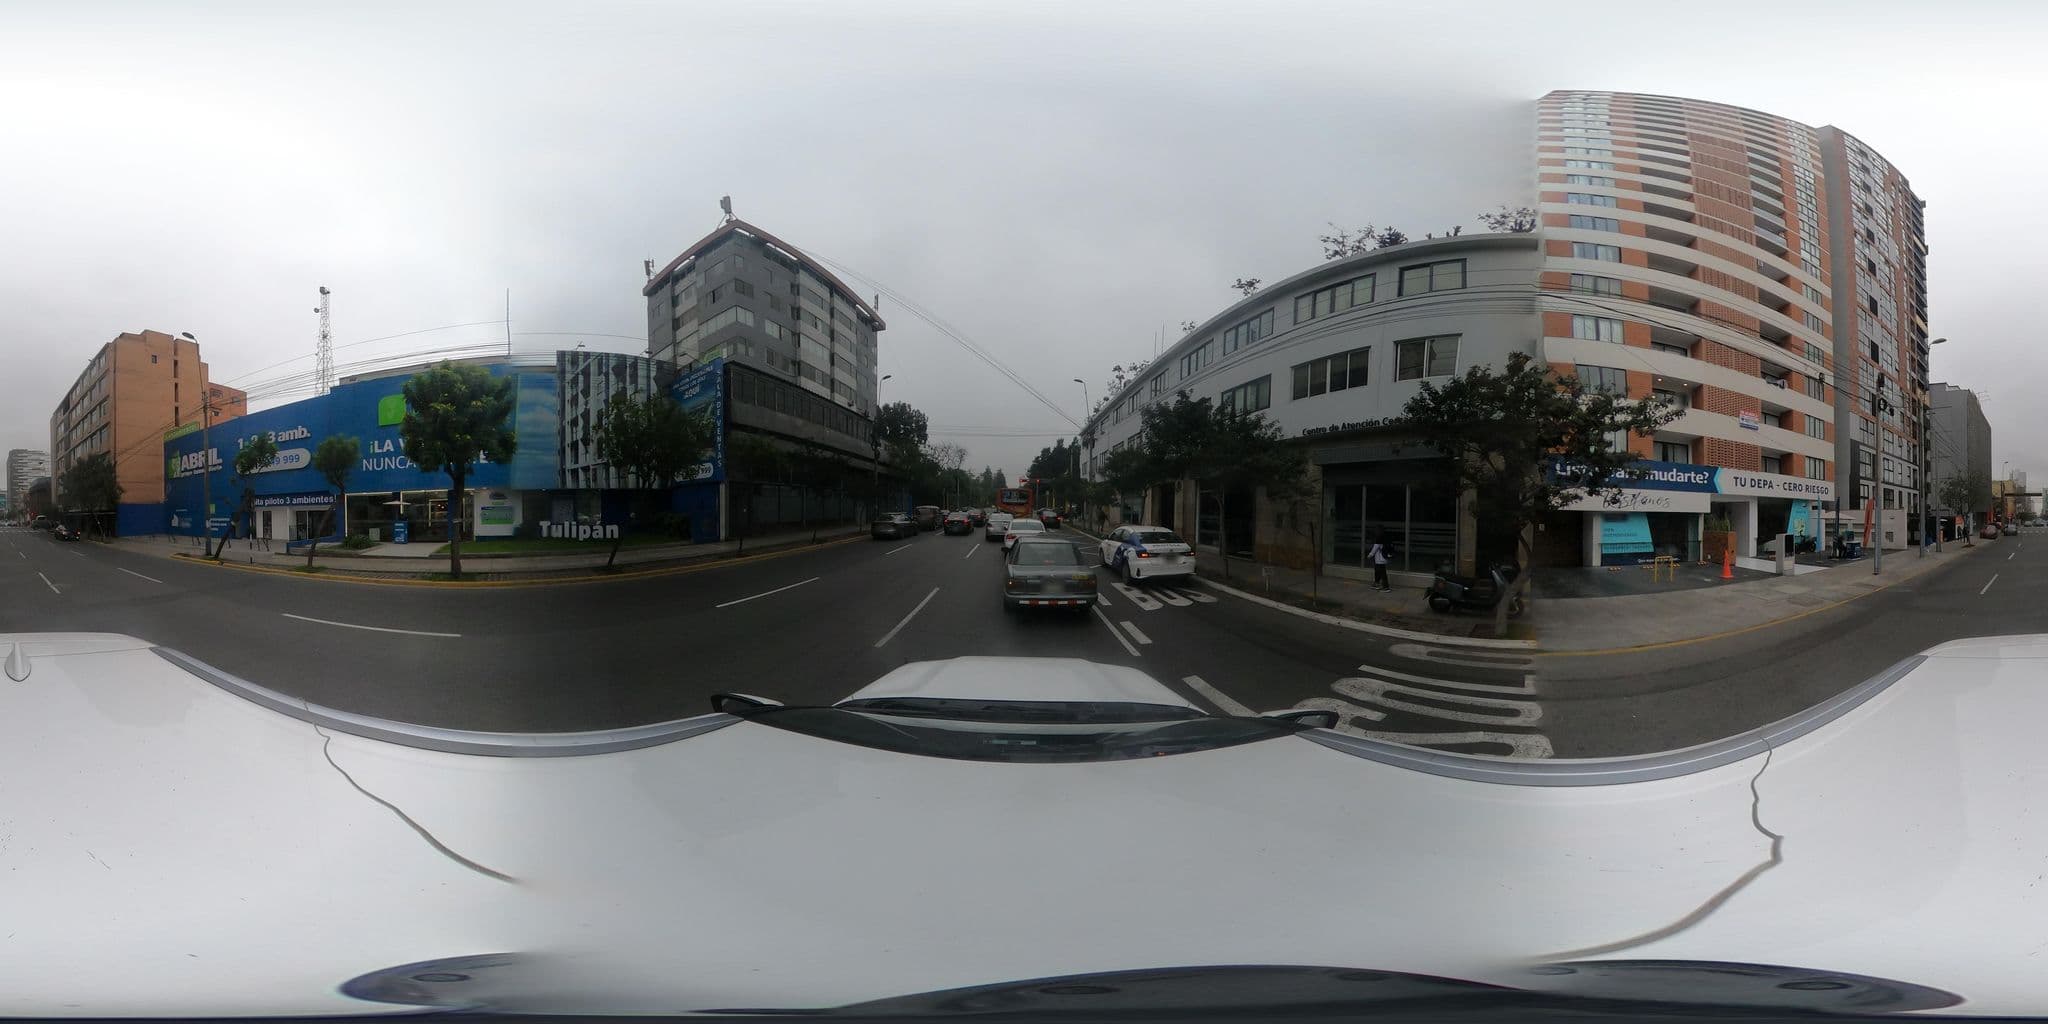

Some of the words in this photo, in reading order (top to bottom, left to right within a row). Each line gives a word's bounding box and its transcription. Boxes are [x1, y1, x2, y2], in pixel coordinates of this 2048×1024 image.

[1302, 426, 1327, 436] Centro
[1329, 423, 1339, 432] de
[1341, 418, 1380, 431] Atención
[237, 437, 244, 449] 1
[267, 431, 277, 444] 3
[277, 425, 311, 442] amb.
[181, 447, 223, 472] ABRIL
[283, 454, 300, 464] 999
[362, 455, 417, 471] NUNCA
[1644, 468, 1710, 484] mudarte?
[1733, 476, 1747, 487] TU
[1750, 478, 1774, 490] DEPA
[1782, 481, 1803, 492] CERO
[1805, 484, 1829, 495] RIESGO
[264, 497, 285, 506] piloto
[285, 496, 291, 504] 3
[292, 493, 337, 504] ambientes!
[538, 520, 619, 541] Tulipán
